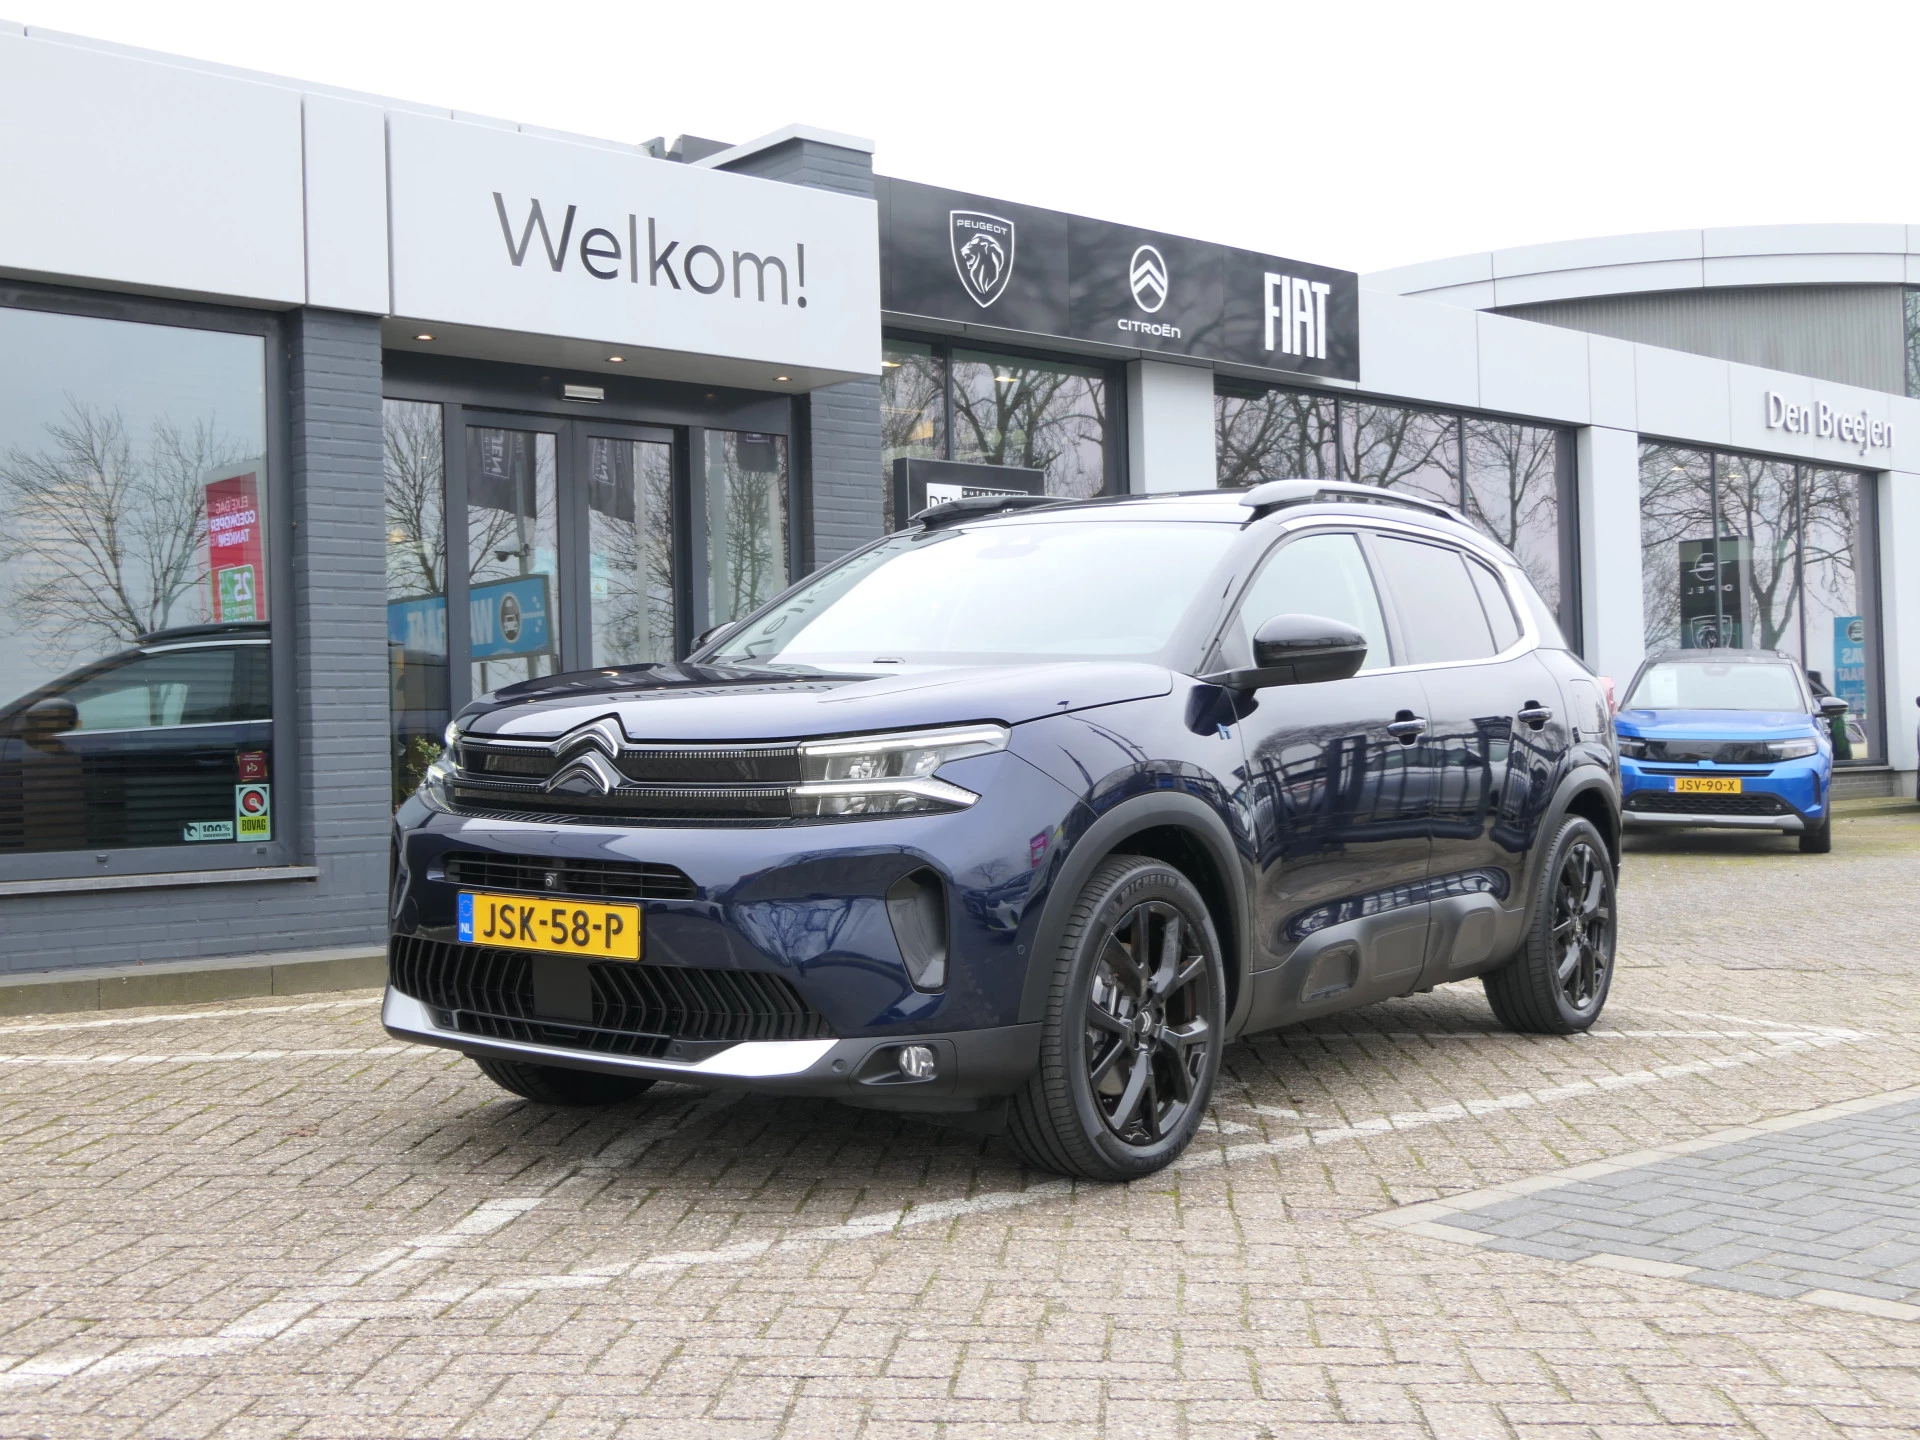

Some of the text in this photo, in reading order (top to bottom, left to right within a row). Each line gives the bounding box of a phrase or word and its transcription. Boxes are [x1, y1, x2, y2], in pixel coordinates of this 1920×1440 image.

[956, 219, 1008, 236] PEUGEOT
[492, 191, 808, 309] Welkom!
[1264, 271, 1331, 360] FIAT
[1765, 391, 1895, 456] Den Breejen
[1679, 780, 1736, 791] JSV-90-X
[242, 819, 267, 832] BOVAG
[1120, 874, 1178, 901] MICHELIN
[460, 903, 624, 949] NL JSK-58-P
